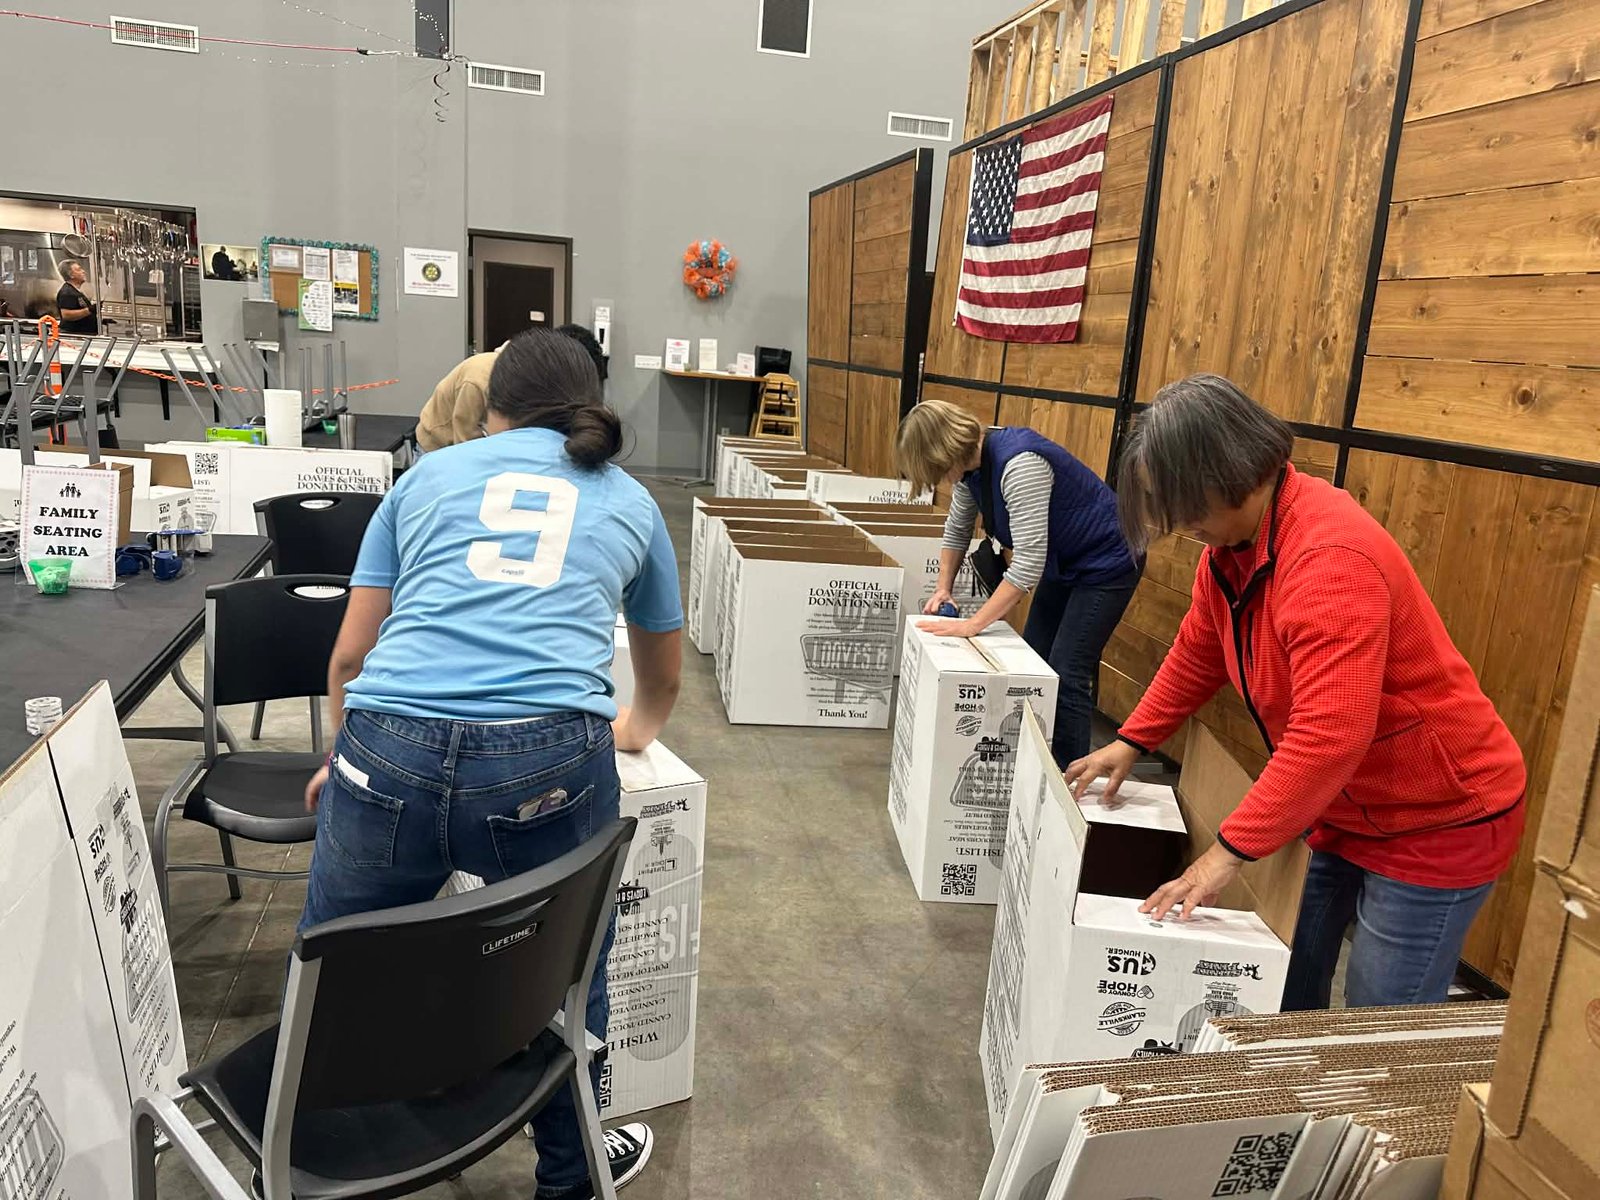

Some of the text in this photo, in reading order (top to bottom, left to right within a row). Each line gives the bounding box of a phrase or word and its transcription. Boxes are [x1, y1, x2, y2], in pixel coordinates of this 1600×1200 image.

[315, 466, 364, 476] OFFICIAL
[298, 474, 335, 484] LOAVES
[337, 475, 347, 484] &
[349, 476, 381, 485] FISHES
[297, 481, 381, 493] DONATION SITE
[882, 489, 909, 498] OFFICI
[39, 506, 99, 520] FAMILY
[33, 525, 103, 539] SEATING
[465, 471, 580, 589] 9
[45, 545, 89, 557] AREA
[829, 579, 882, 591] OFFICIAL
[809, 587, 900, 601] LOAVES & FISHES
[808, 596, 898, 610] DONATION SITE
[817, 708, 868, 719] Thank You!
[955, 847, 981, 856] LIST:
[634, 917, 669, 930] CANNED
[489, 927, 531, 951] LIFETIME
[620, 949, 655, 962] CANNED
[617, 983, 653, 997] CANNED
[1098, 980, 1138, 993] HOPE
[1107, 989, 1137, 998] CONVOY
[631, 997, 666, 1011] CANNED
[637, 1013, 672, 1026] CANNED
[1098, 1012, 1146, 1026] CLARKSVILLE
[619, 1031, 659, 1050] WISH
